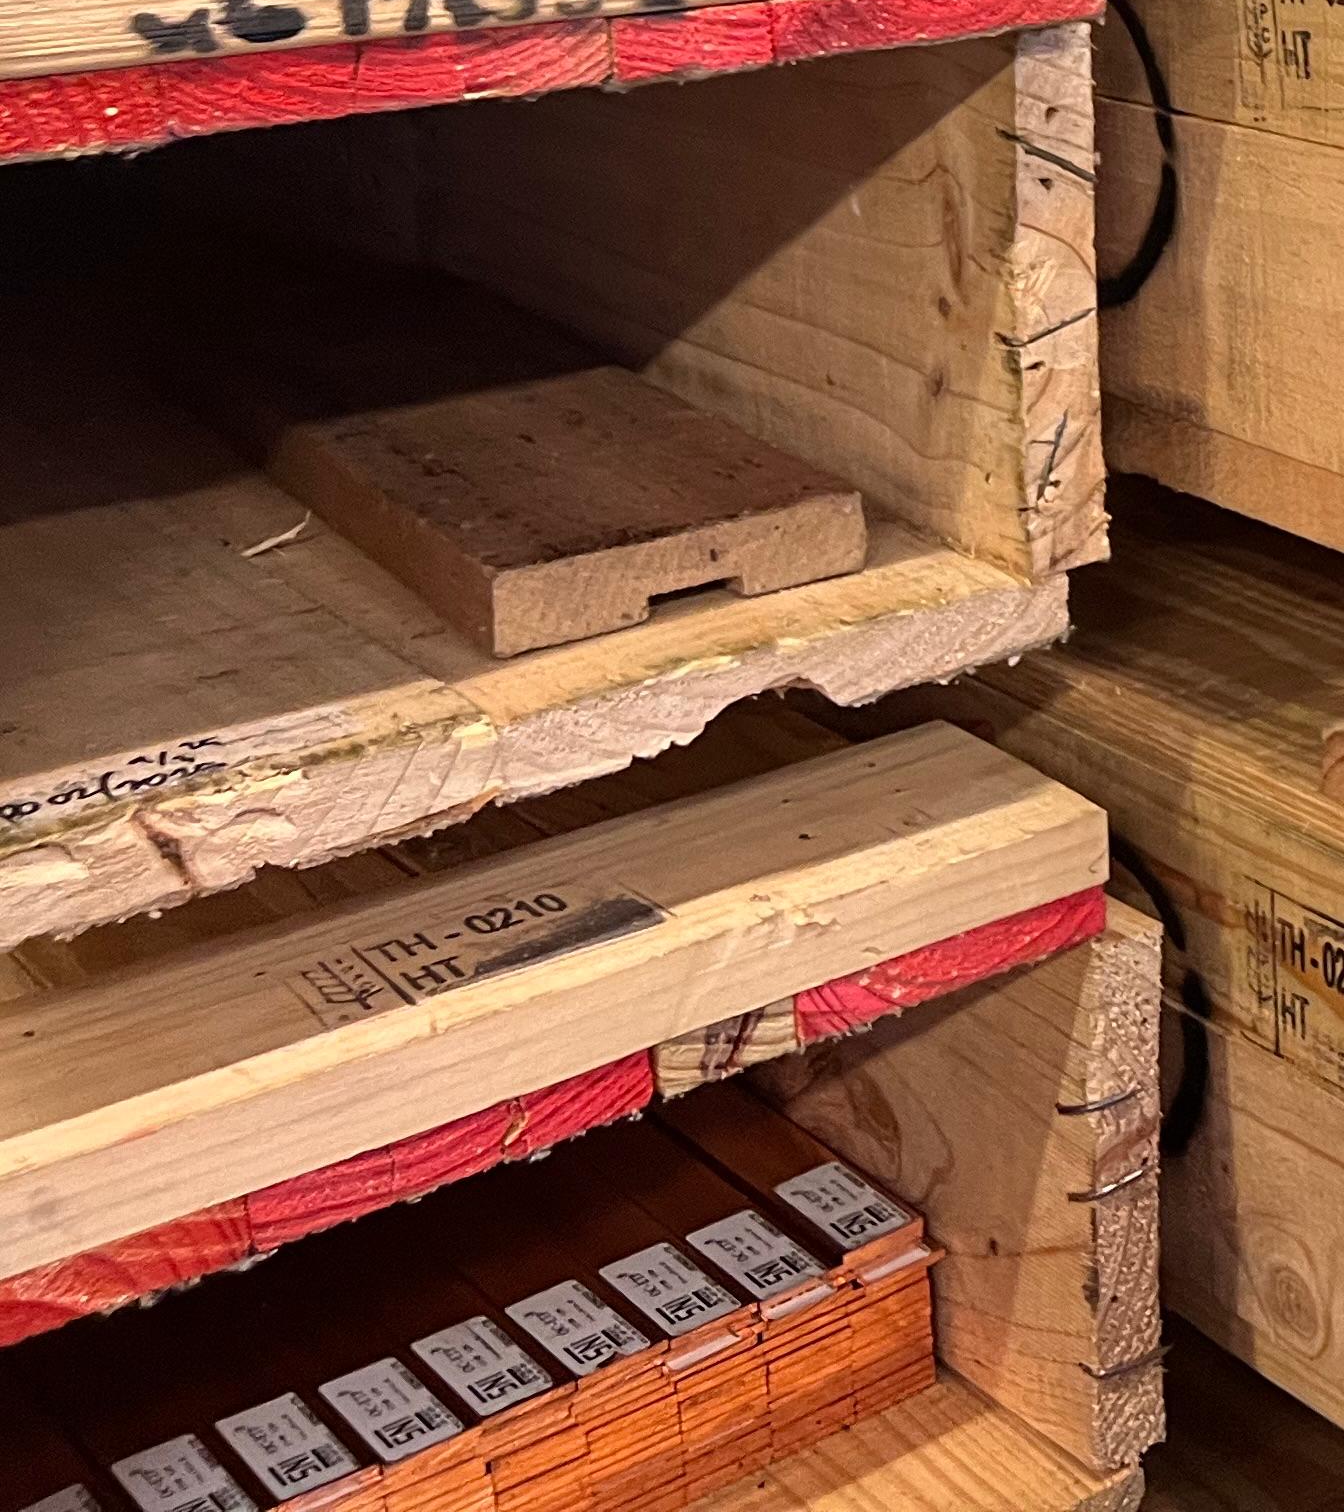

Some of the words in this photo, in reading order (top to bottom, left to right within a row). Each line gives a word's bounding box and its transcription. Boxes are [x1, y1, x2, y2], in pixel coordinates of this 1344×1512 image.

[1281, 29, 1312, 81] HT
[399, 955, 467, 992] HT
[1280, 988, 1310, 1040] HT
